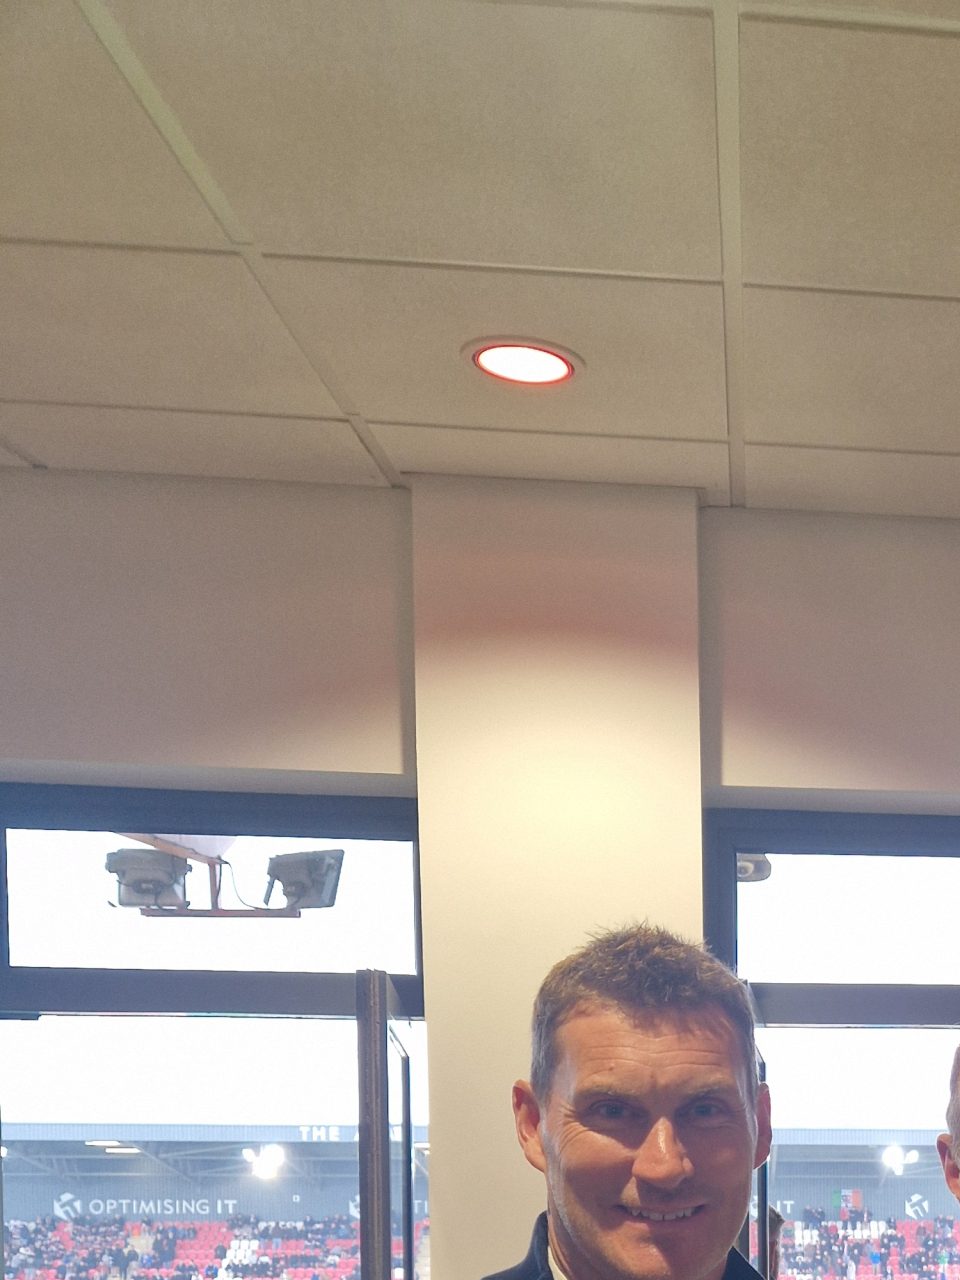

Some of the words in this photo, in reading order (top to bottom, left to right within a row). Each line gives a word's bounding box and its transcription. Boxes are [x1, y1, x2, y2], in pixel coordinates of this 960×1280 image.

[299, 1125, 340, 1141] THE
[89, 1198, 210, 1215] OPTIMISING
[216, 1199, 238, 1214] IT
[776, 1200, 795, 1214] IT
